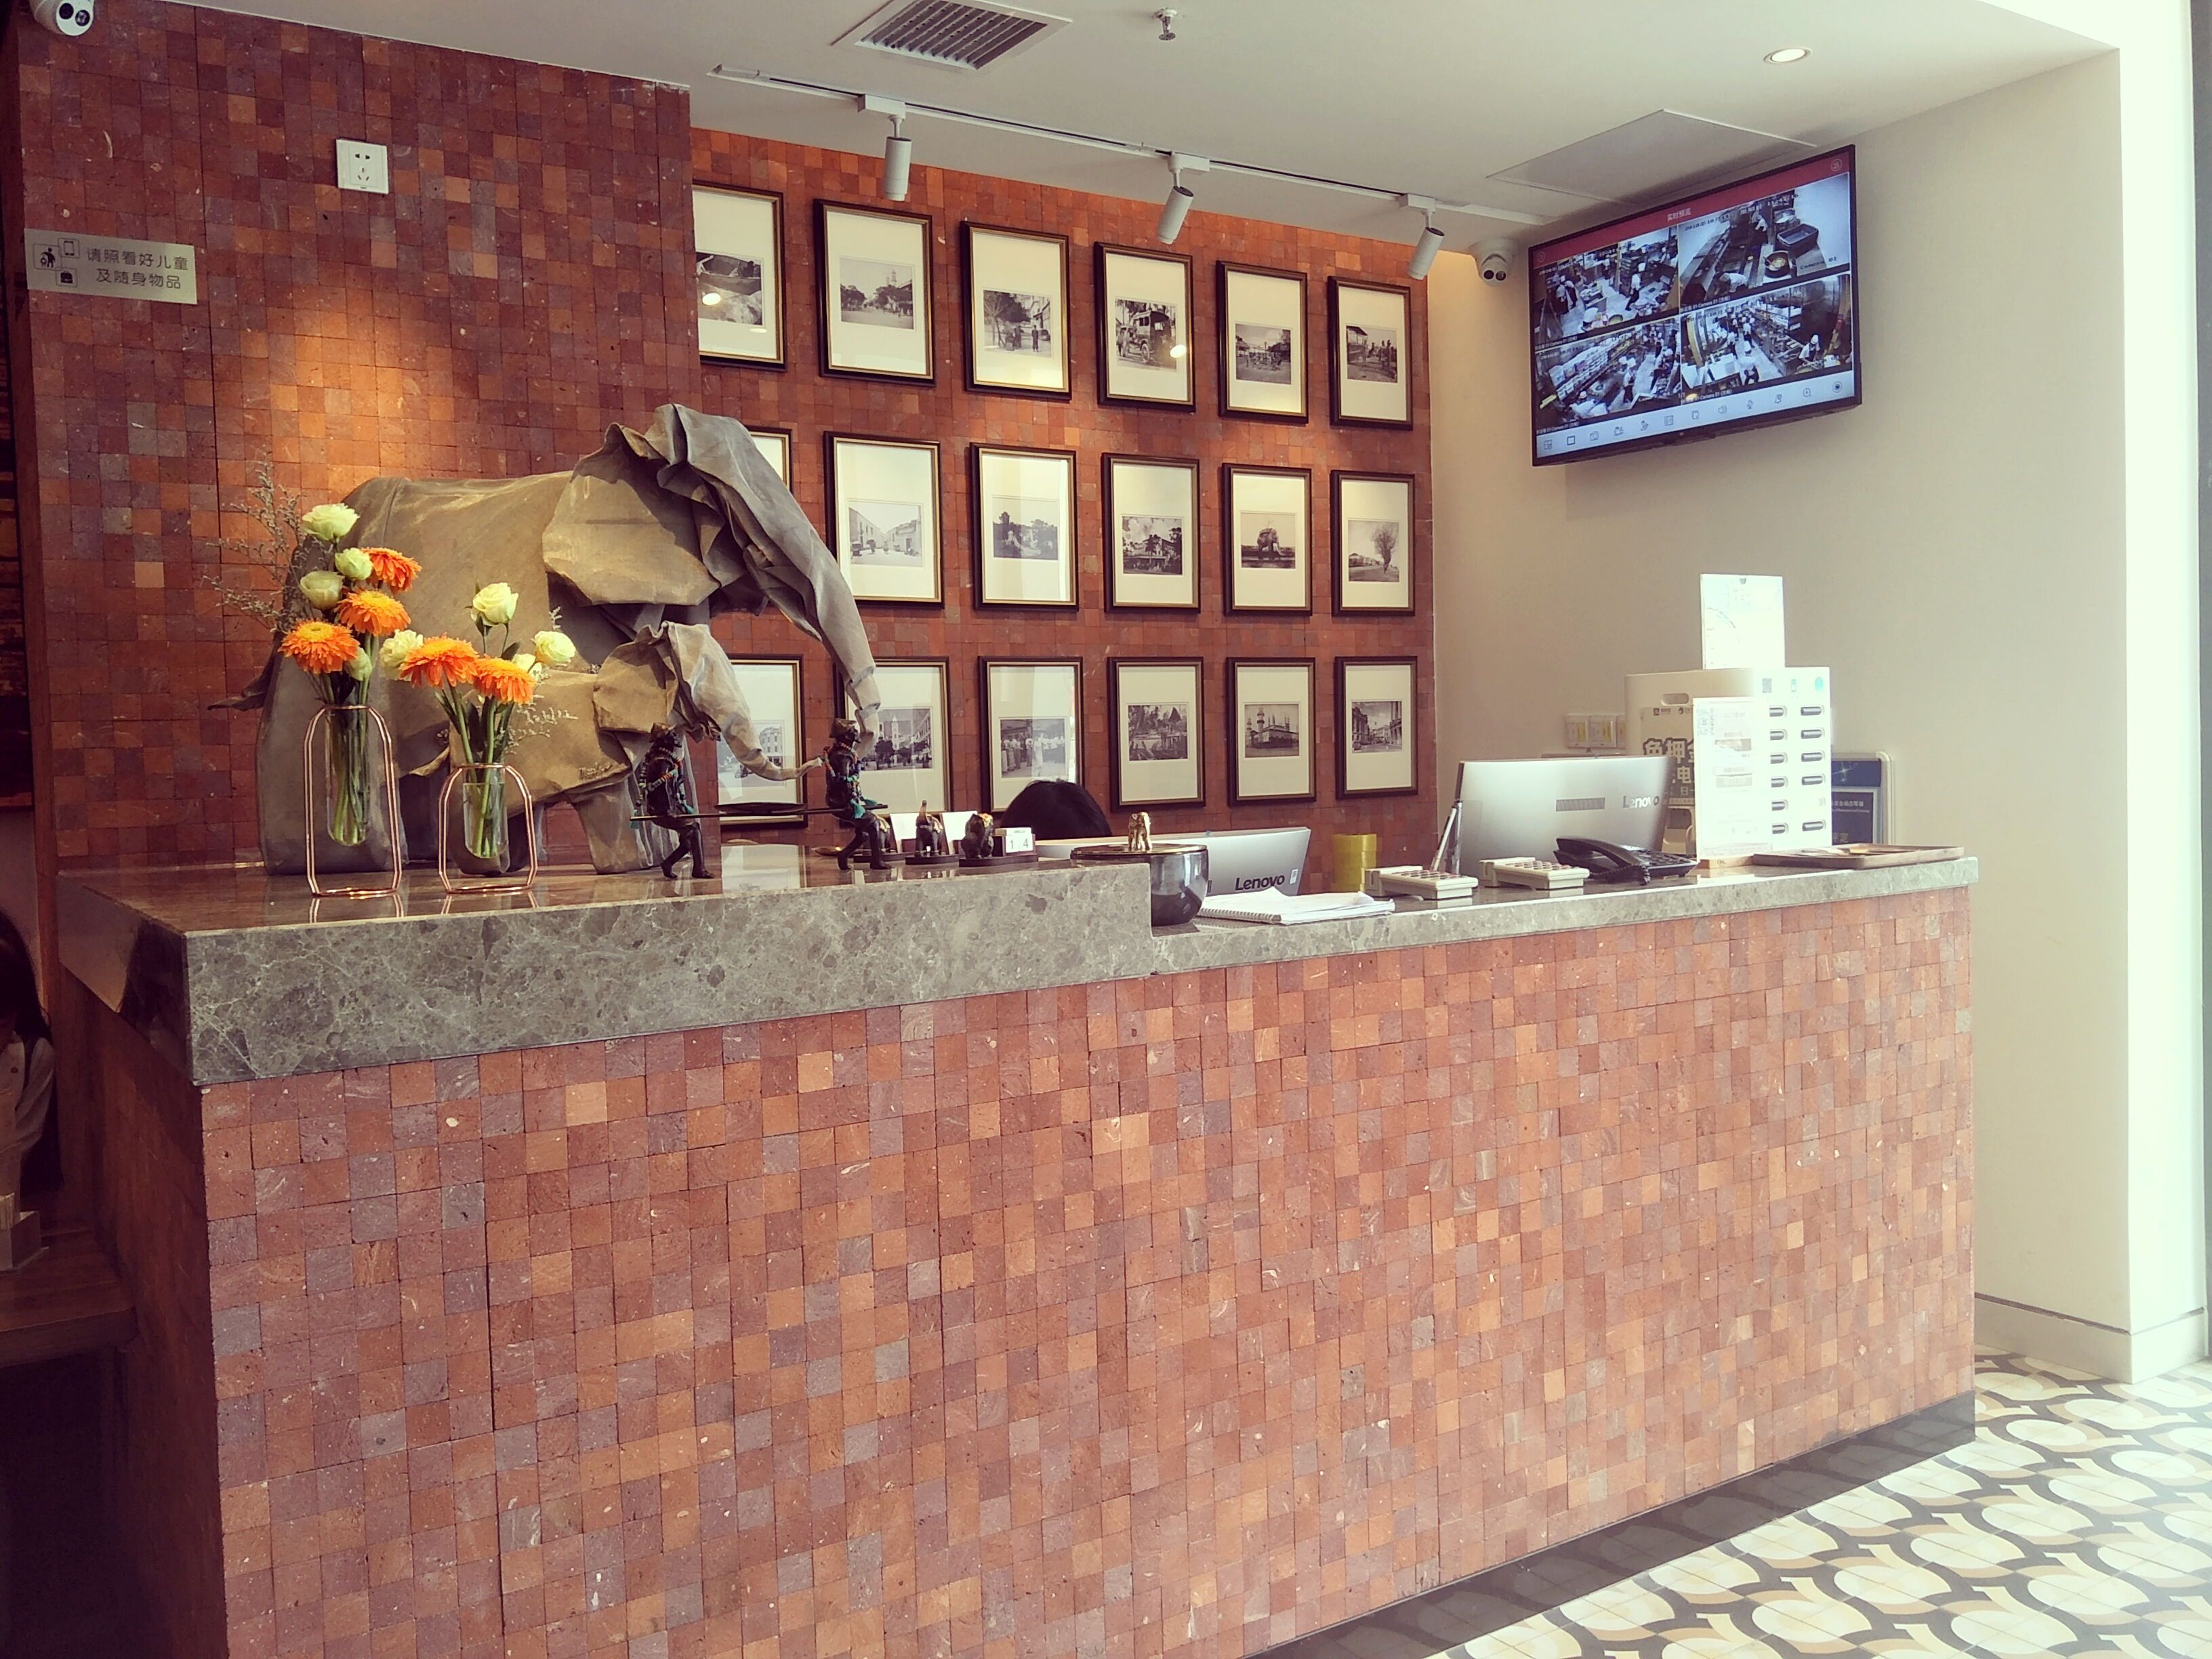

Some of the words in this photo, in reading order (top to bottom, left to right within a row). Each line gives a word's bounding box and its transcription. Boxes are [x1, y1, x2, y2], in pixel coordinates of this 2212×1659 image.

[87, 247, 188, 270] 请照看好儿童
[96, 268, 181, 289] 及随身物品
[1622, 796, 1660, 808] Lenovo
[1023, 838, 1029, 848] 4
[1235, 874, 1286, 891] Lenovo
